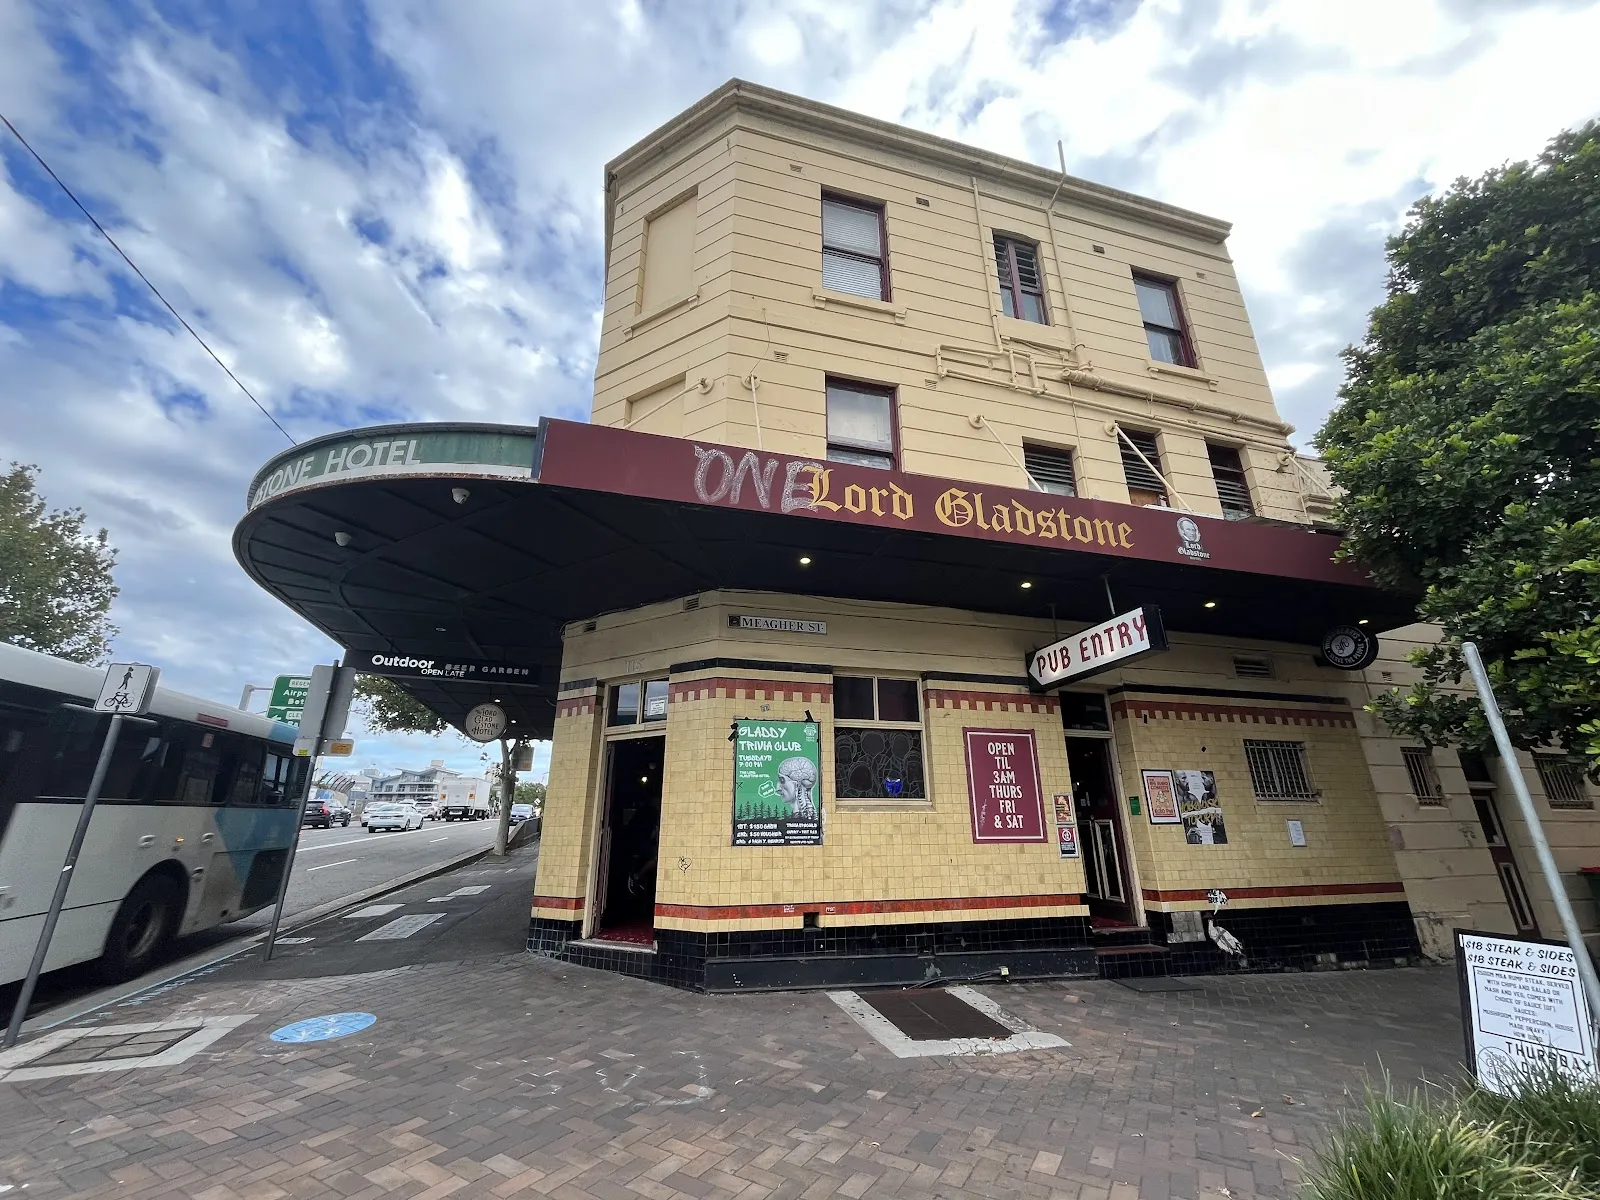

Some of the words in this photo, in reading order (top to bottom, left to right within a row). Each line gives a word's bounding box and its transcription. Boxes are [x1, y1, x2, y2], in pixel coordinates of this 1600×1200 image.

[324, 440, 420, 476] HOTEL
[692, 444, 824, 514] ONE
[800, 465, 914, 521] Lord
[934, 486, 1136, 550] Gladstone
[742, 617, 804, 630] MEAGHER
[1036, 646, 1071, 677] PUB
[1079, 614, 1146, 662] ENTRY
[372, 654, 434, 669] Outdoor
[445, 663, 476, 672] BEER
[482, 666, 529, 676] GARDEN
[738, 726, 787, 738] GLADDY
[739, 741, 772, 751] TRIVIA
[774, 742, 802, 751] CLUB
[988, 742, 1014, 755] OPEN
[995, 757, 1011, 769] TIL
[993, 771, 1016, 784] 3AM
[989, 785, 1023, 799] THURS
[1000, 800, 1016, 813] FRI
[994, 815, 1003, 828] &
[1007, 815, 1024, 828] SAT
[1466, 941, 1482, 950] $18
[1485, 943, 1521, 956] STEAK
[1525, 948, 1534, 957] &
[1538, 950, 1574, 962] SIDES
[1467, 954, 1485, 963] $18
[1488, 957, 1523, 970] STEAK
[1527, 962, 1536, 971] &
[1540, 964, 1576, 977] SIDES
[1532, 986, 1551, 994] SALAD
[1547, 981, 1569, 989] SERVED
[1527, 994, 1546, 1002] COMES
[1524, 1001, 1542, 1009] SAUCE
